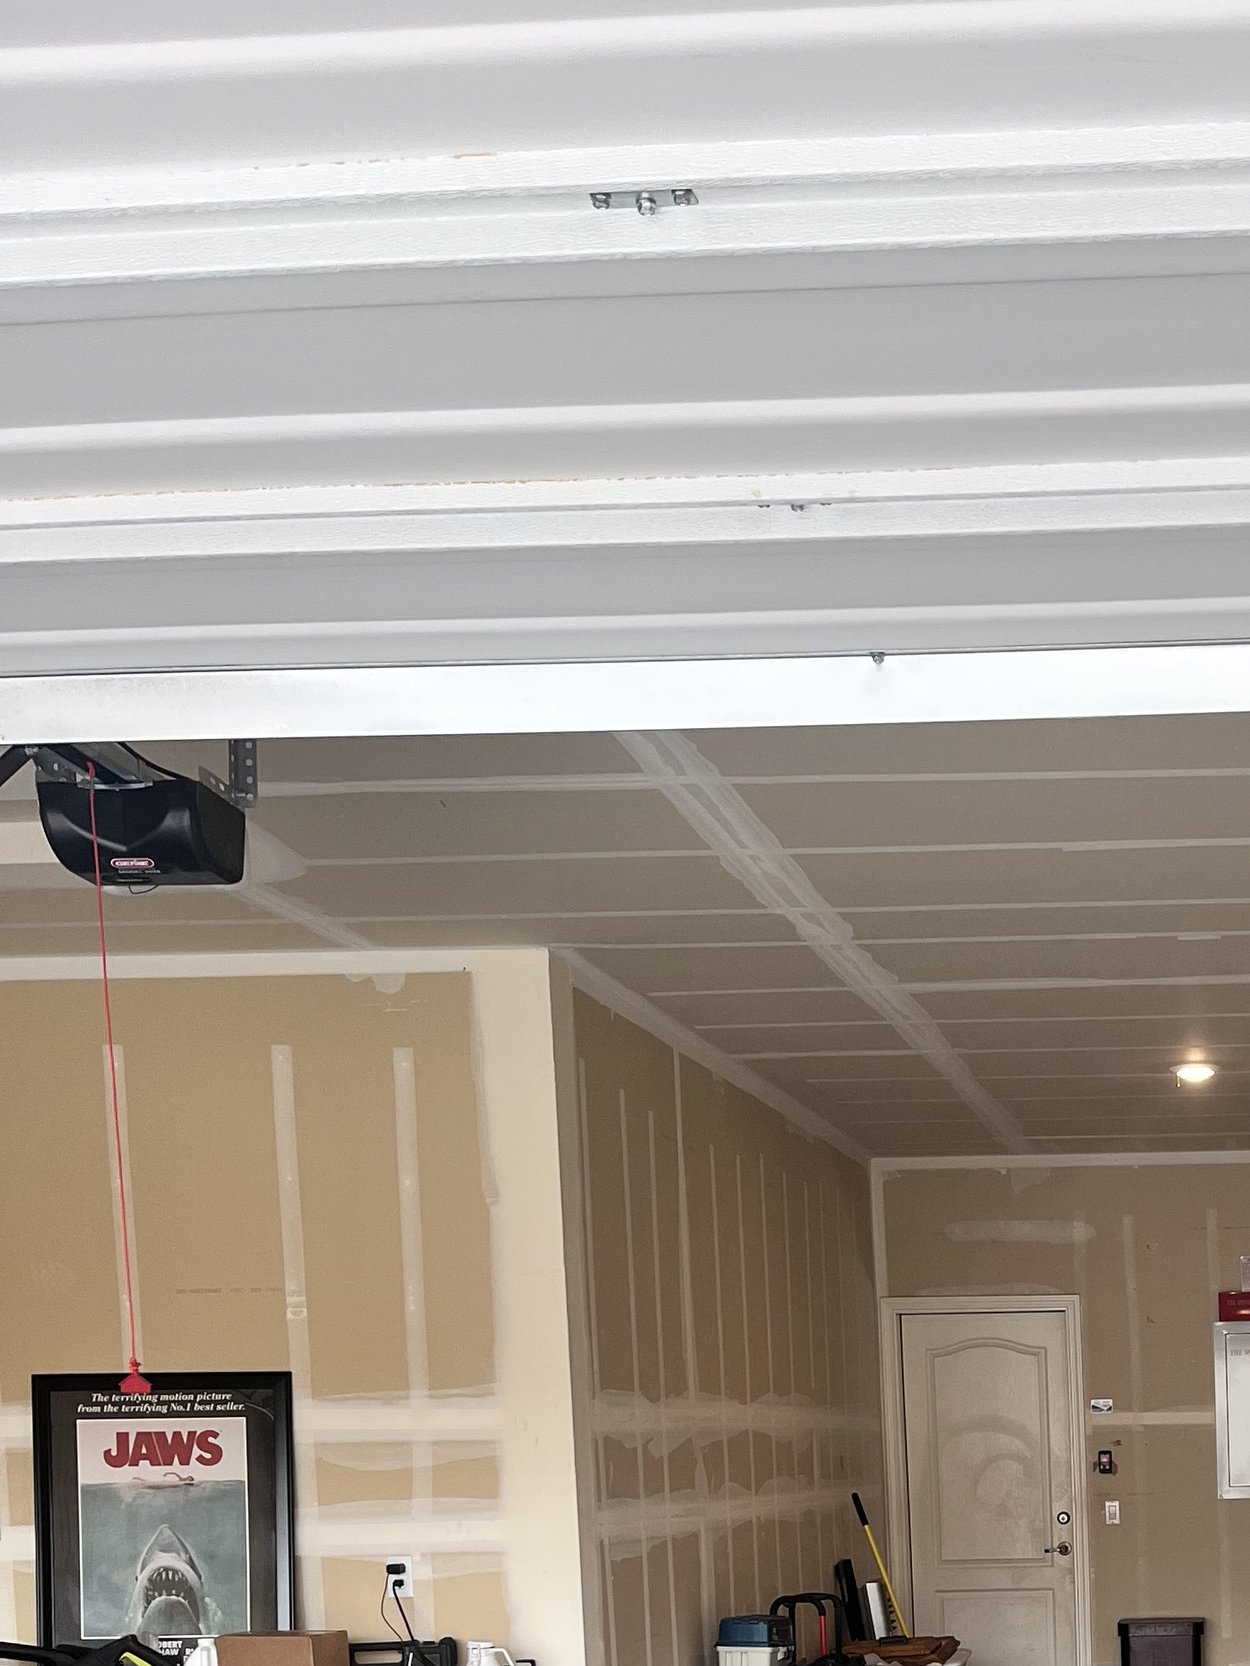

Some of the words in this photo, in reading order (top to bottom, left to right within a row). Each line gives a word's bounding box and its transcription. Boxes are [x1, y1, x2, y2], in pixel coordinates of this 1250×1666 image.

[91, 1393, 109, 1402] The
[111, 1392, 158, 1405] terrifying
[159, 1392, 194, 1401] motion
[196, 1392, 232, 1402] picture
[77, 1404, 101, 1414] from
[103, 1404, 118, 1413] the
[121, 1404, 168, 1414] terrifying
[194, 1402, 214, 1411] best
[216, 1402, 246, 1411] seller.
[103, 1429, 224, 1468] JAWS
[158, 1641, 183, 1649] BERT
